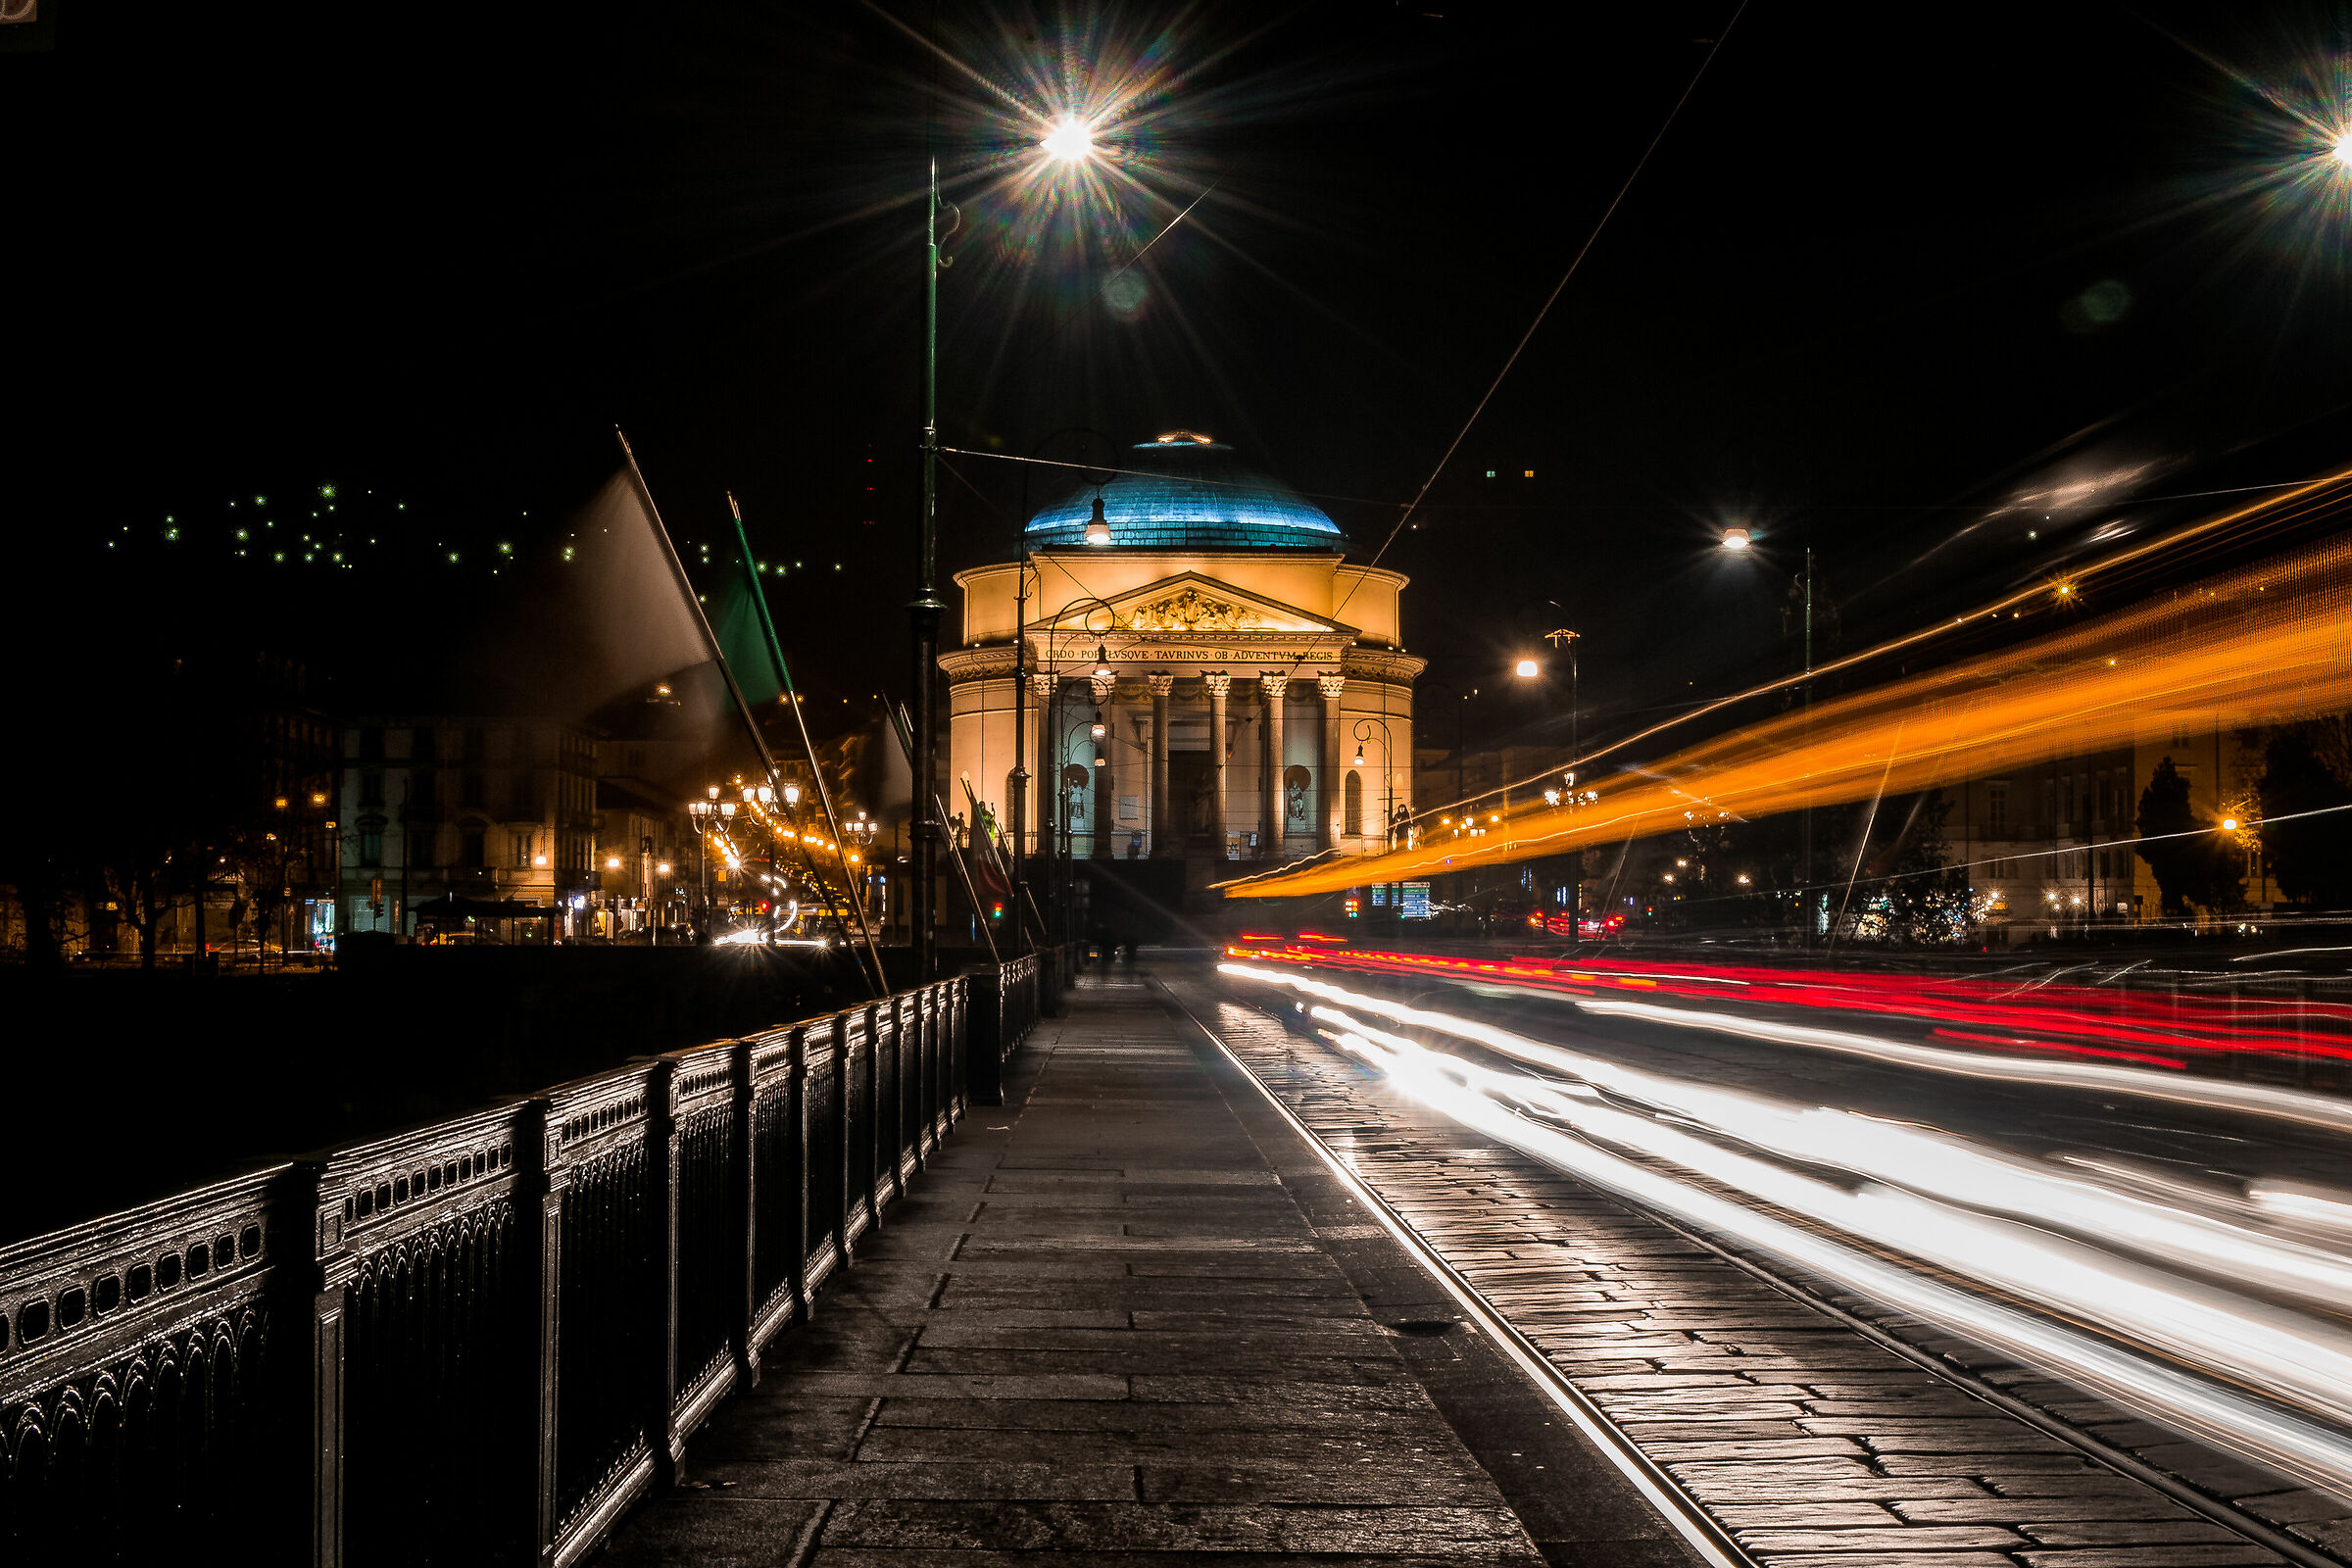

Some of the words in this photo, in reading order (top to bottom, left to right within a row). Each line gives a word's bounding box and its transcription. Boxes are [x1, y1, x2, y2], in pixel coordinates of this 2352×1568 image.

[1046, 650, 1075, 659] ORDO
[1154, 651, 1208, 660] TAVRINVS
[1214, 651, 1228, 660] OB
[1233, 651, 1297, 660] ADVENTVM
[1302, 651, 1333, 661] REGIS
